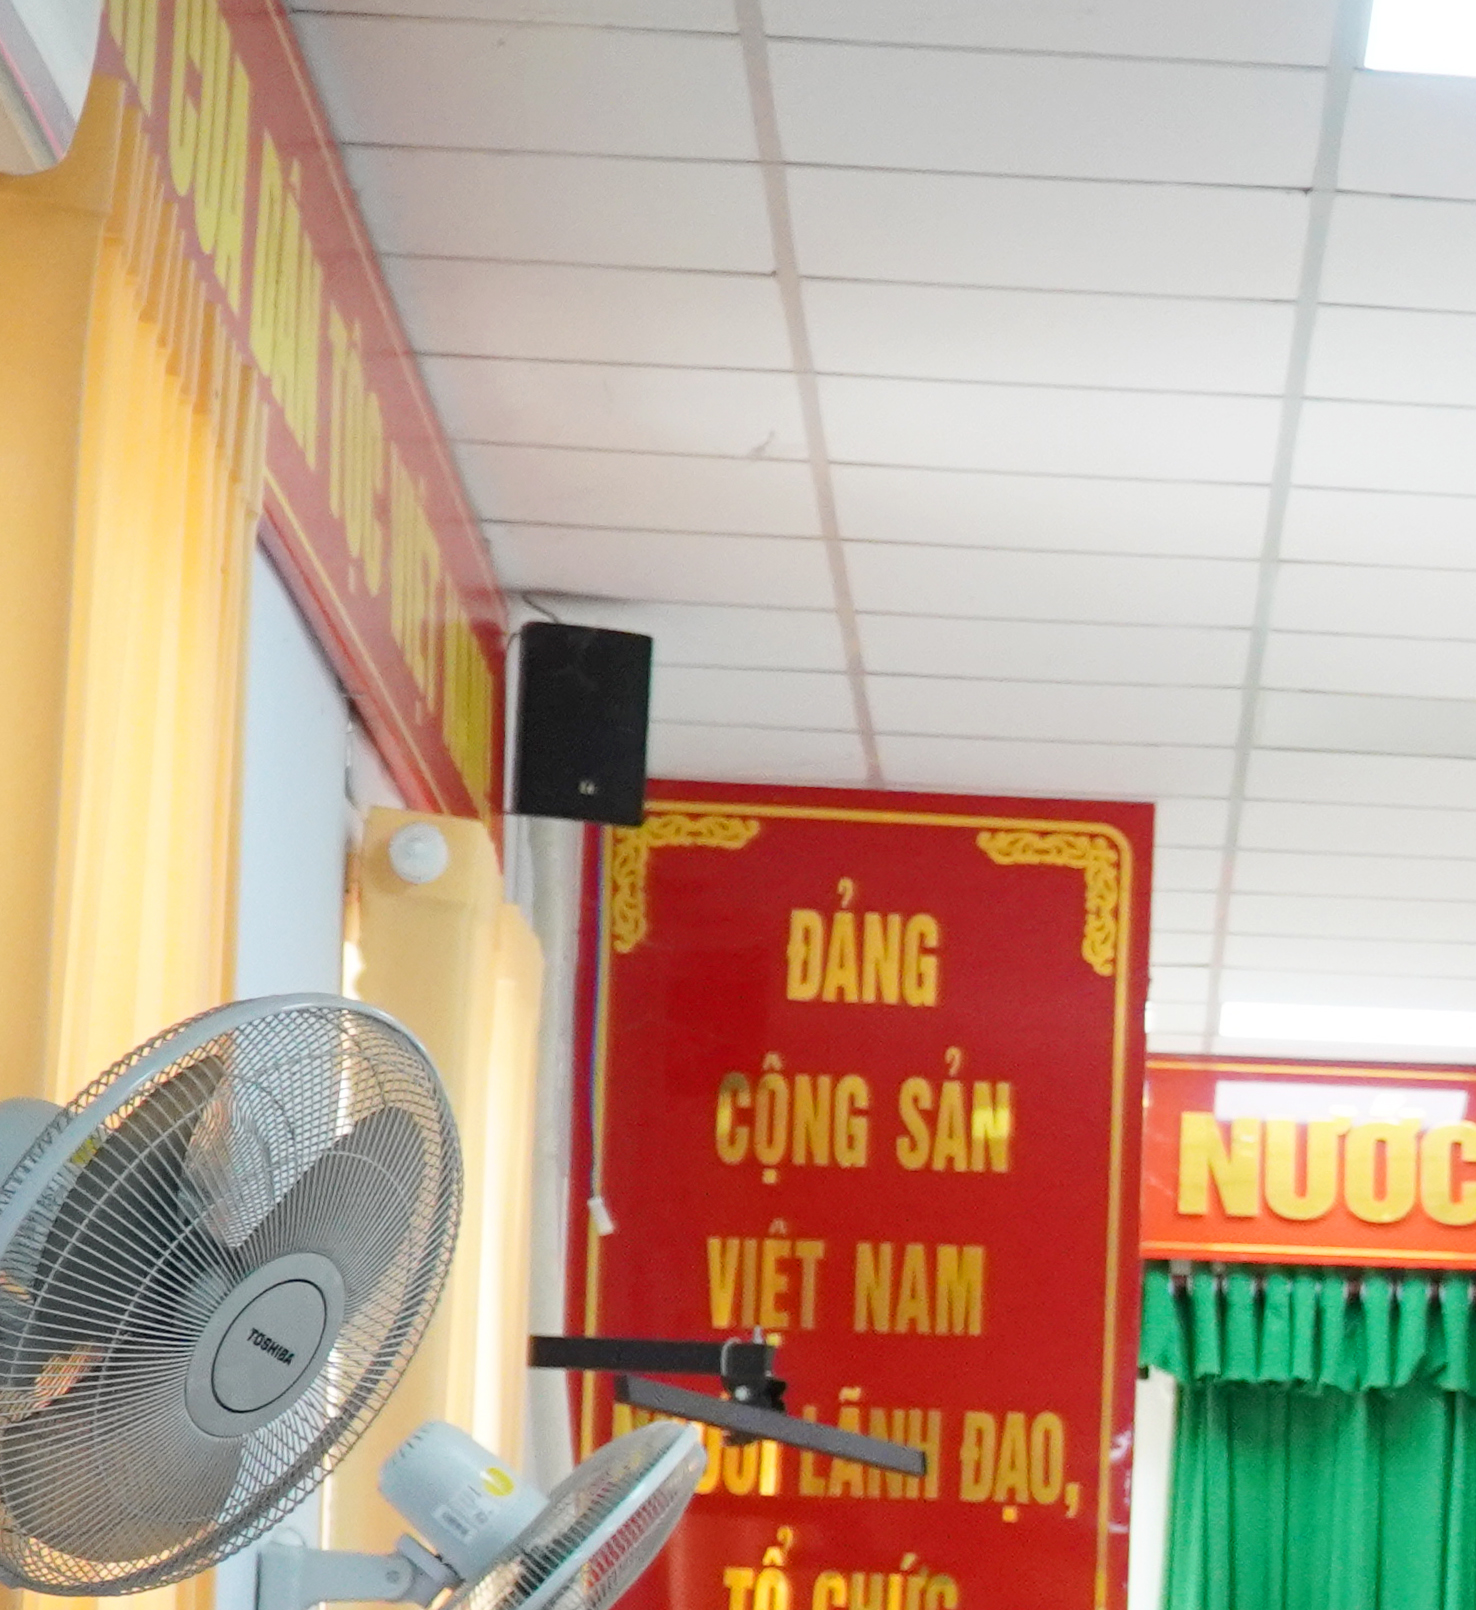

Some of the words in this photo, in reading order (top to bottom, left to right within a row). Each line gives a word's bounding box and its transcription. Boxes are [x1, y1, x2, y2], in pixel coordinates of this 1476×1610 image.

[786, 878, 941, 1008] ĐẢNG
[715, 1051, 871, 1184] CỘNG
[896, 1047, 1012, 1172] SẢN
[246, 1327, 294, 1366] TOSHIBA
[707, 1218, 824, 1349] VIỆT
[854, 1242, 985, 1337] NAM
[800, 1387, 941, 1499] LÃNH
[959, 1410, 1081, 1522] ĐẠO,
